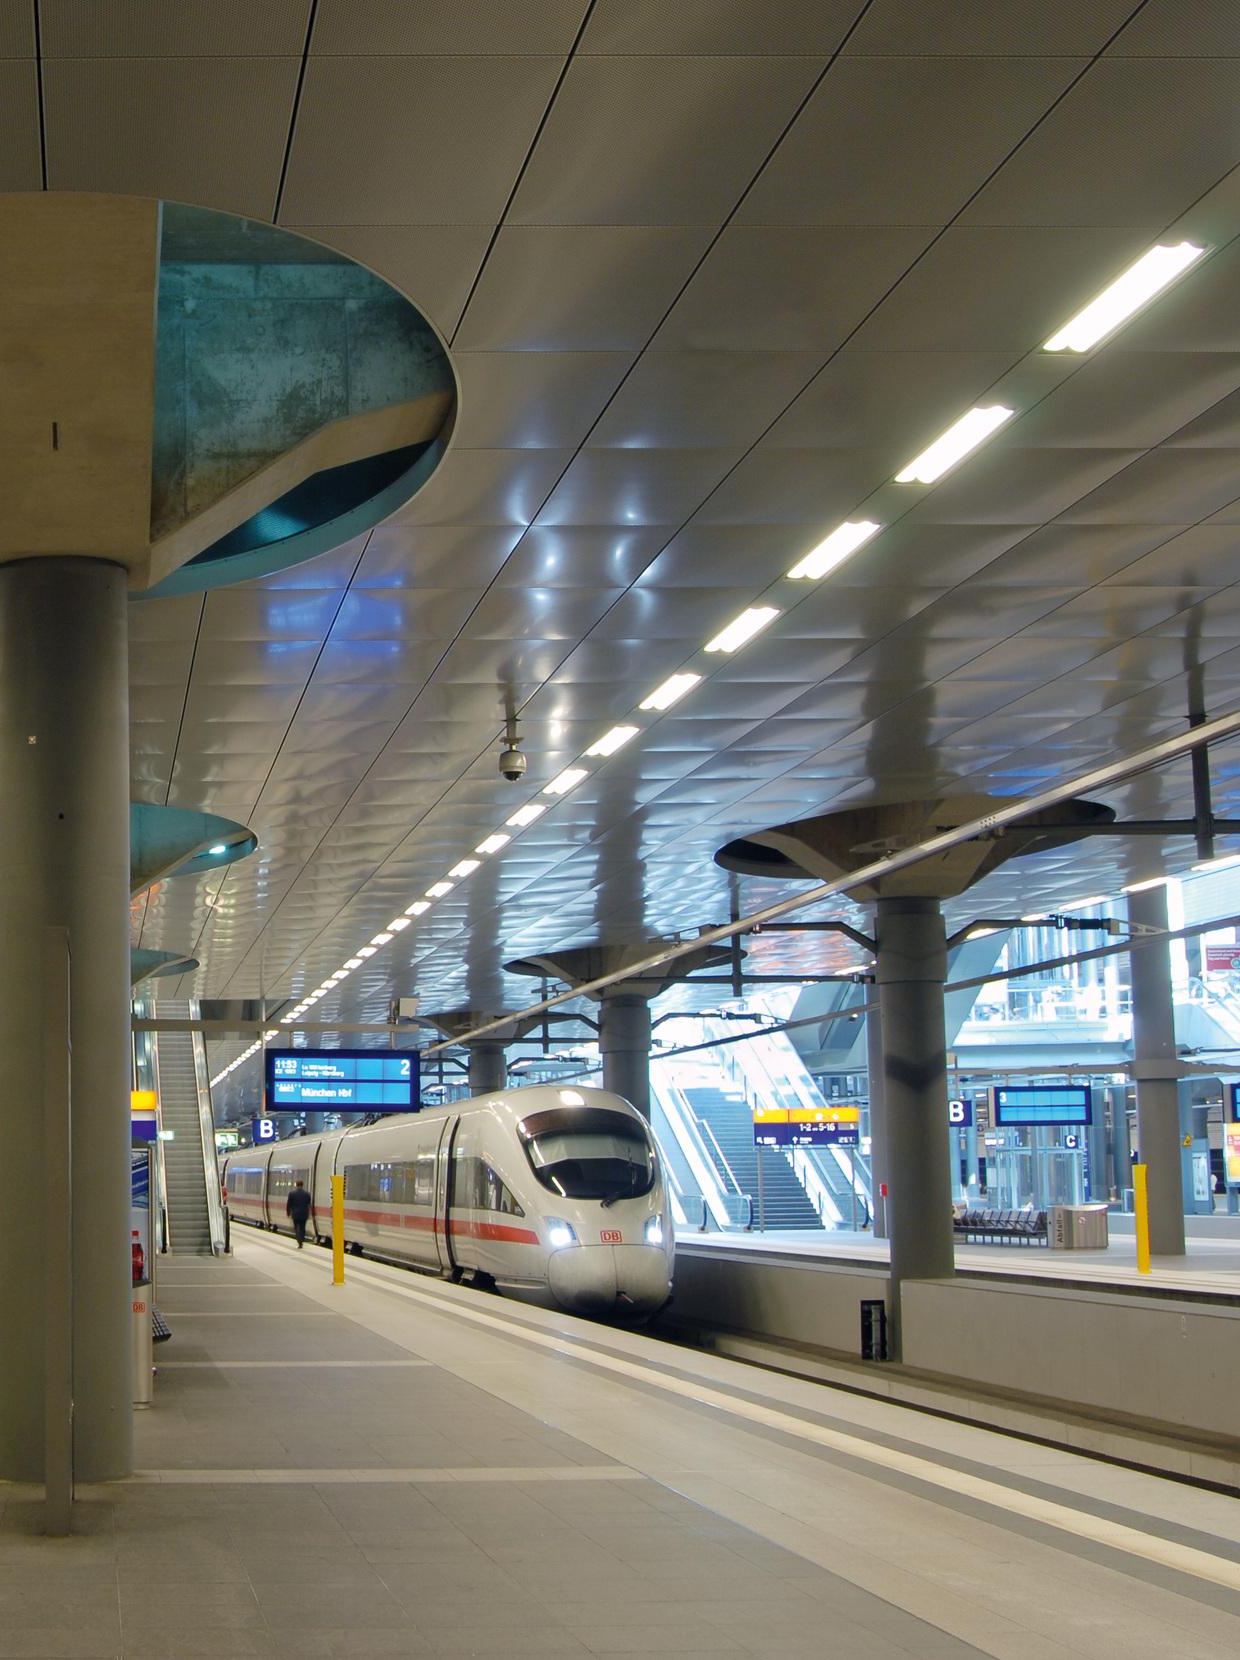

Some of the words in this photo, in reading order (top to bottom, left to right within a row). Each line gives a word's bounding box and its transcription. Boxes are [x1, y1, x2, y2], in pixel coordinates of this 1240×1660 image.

[400, 1060, 410, 1075] 2
[301, 1088, 337, 1097] München
[338, 1089, 352, 1097] Hbf
[1000, 1092, 1007, 1103] 3
[949, 1101, 964, 1122] B
[260, 1119, 274, 1138] B
[819, 1123, 835, 1131] 5-16
[1066, 1135, 1076, 1147] C
[603, 1232, 619, 1240] DB
